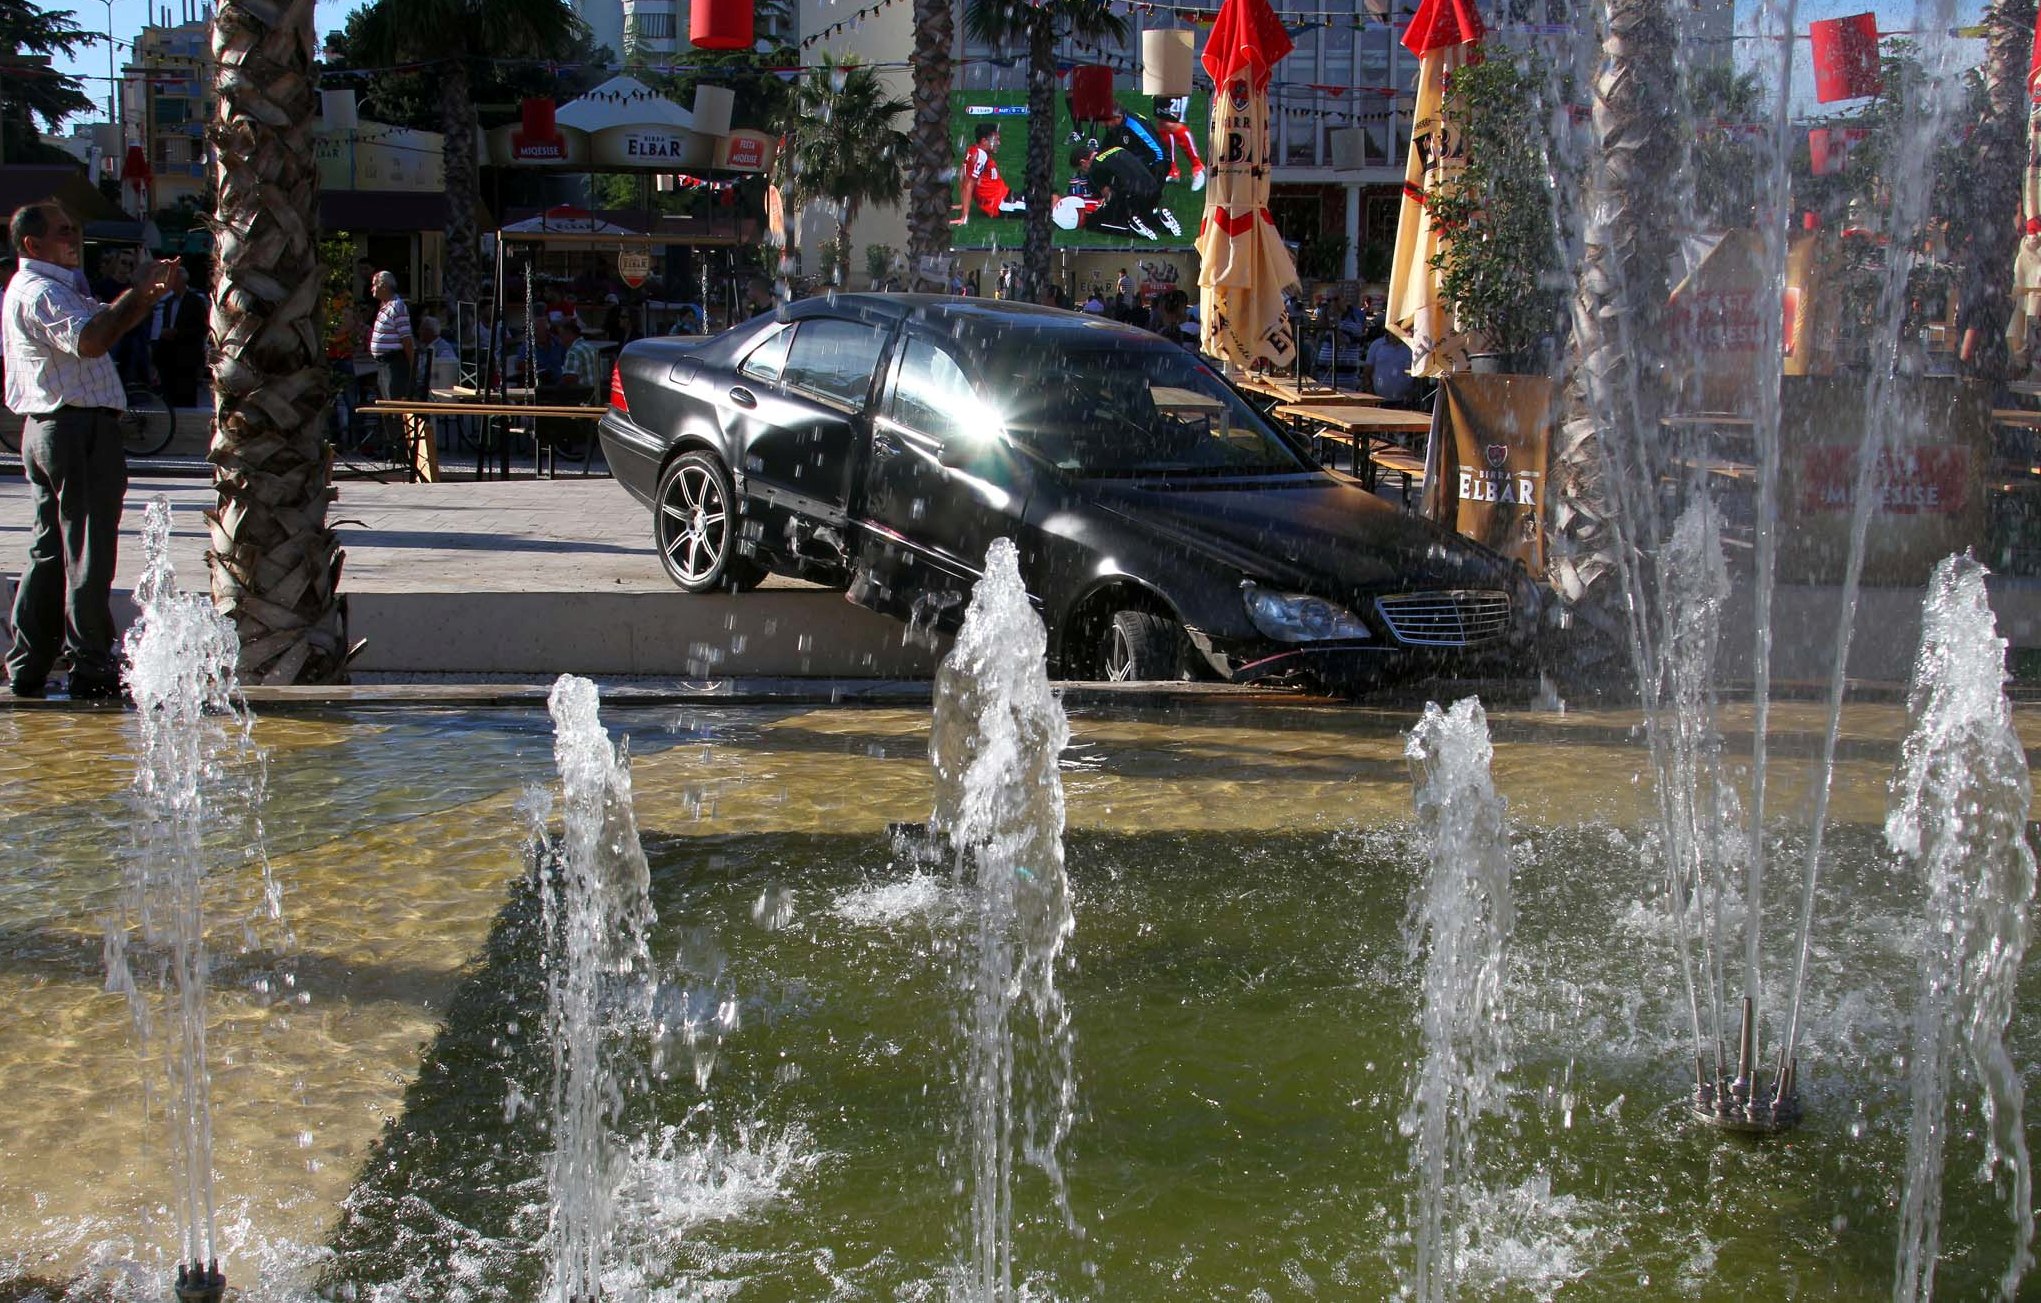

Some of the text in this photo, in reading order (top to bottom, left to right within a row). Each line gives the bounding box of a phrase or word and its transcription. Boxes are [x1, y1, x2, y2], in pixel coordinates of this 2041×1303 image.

[1170, 98, 1181, 113] 21
[628, 139, 681, 157] ELBAR
[1479, 469, 1512, 481] BIRRA
[1458, 473, 1537, 506] ELBAR
